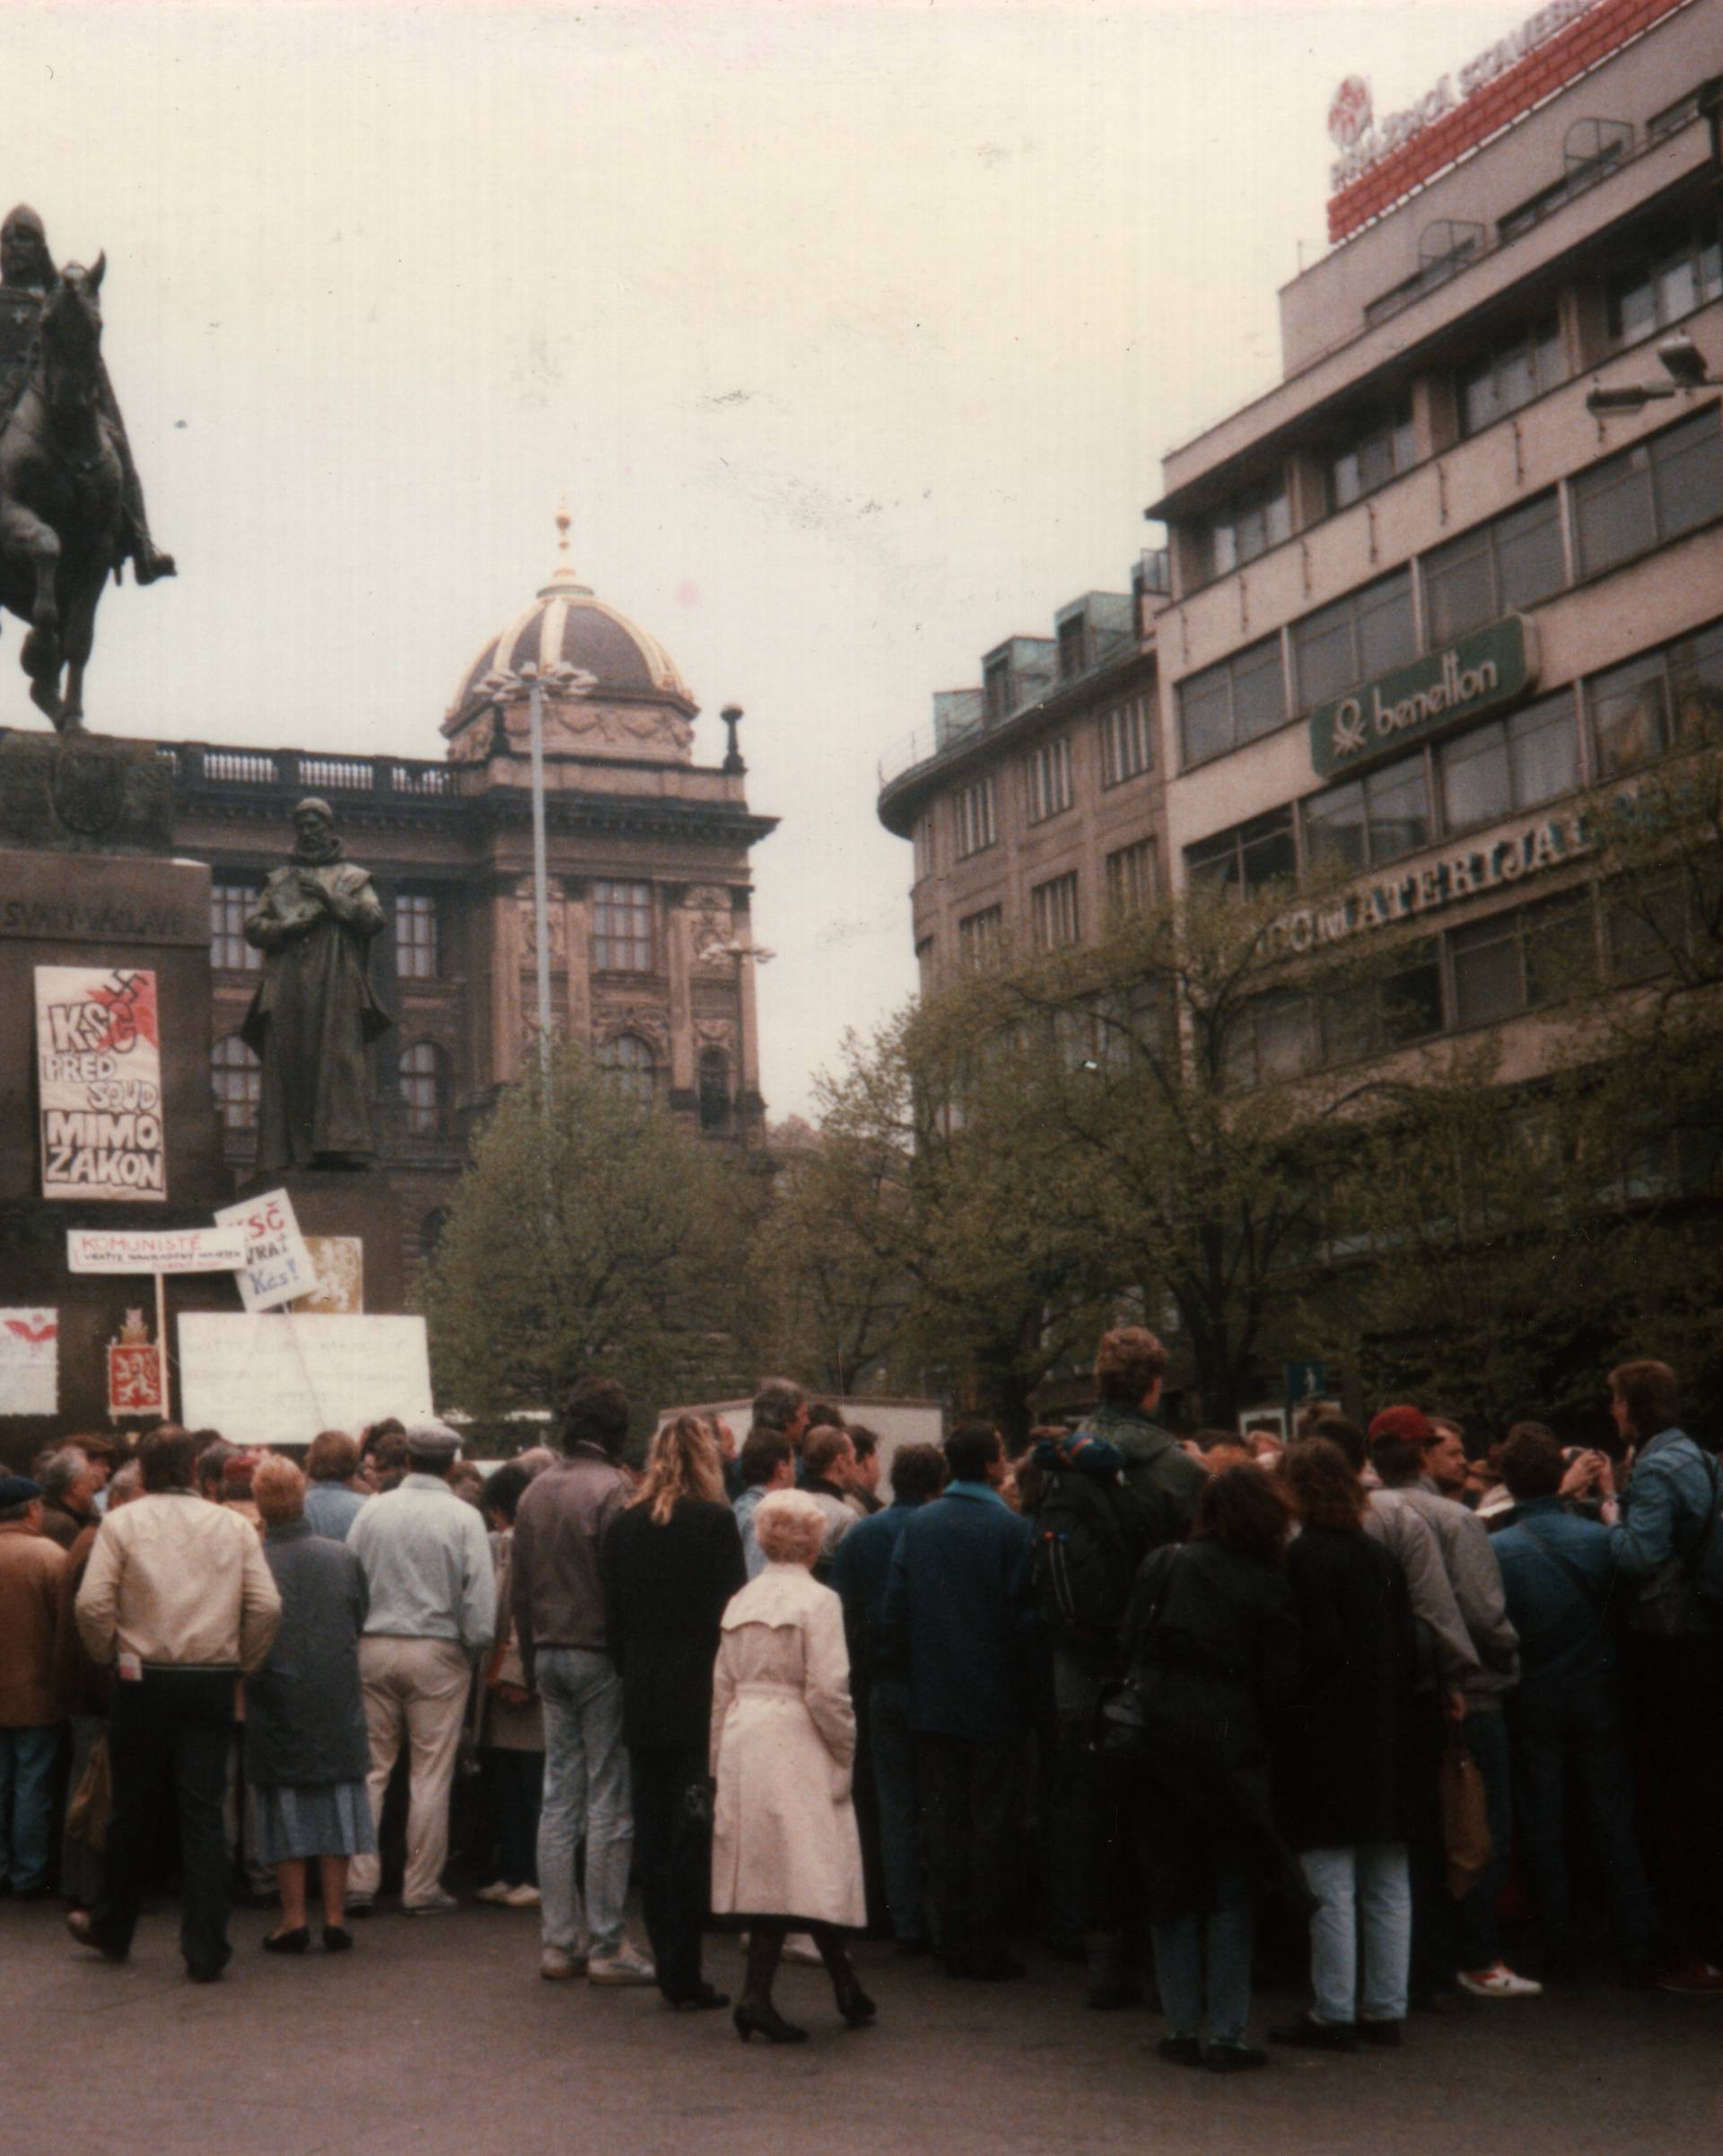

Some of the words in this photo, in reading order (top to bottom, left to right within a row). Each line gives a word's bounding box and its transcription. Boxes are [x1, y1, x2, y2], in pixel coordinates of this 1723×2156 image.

[1373, 648, 1499, 737] benetton
[88, 1079, 159, 1112] SOUD
[44, 1109, 161, 1150] MIMO
[228, 1200, 285, 1239] SČ
[81, 1232, 202, 1251] KOMUNISTÉ
